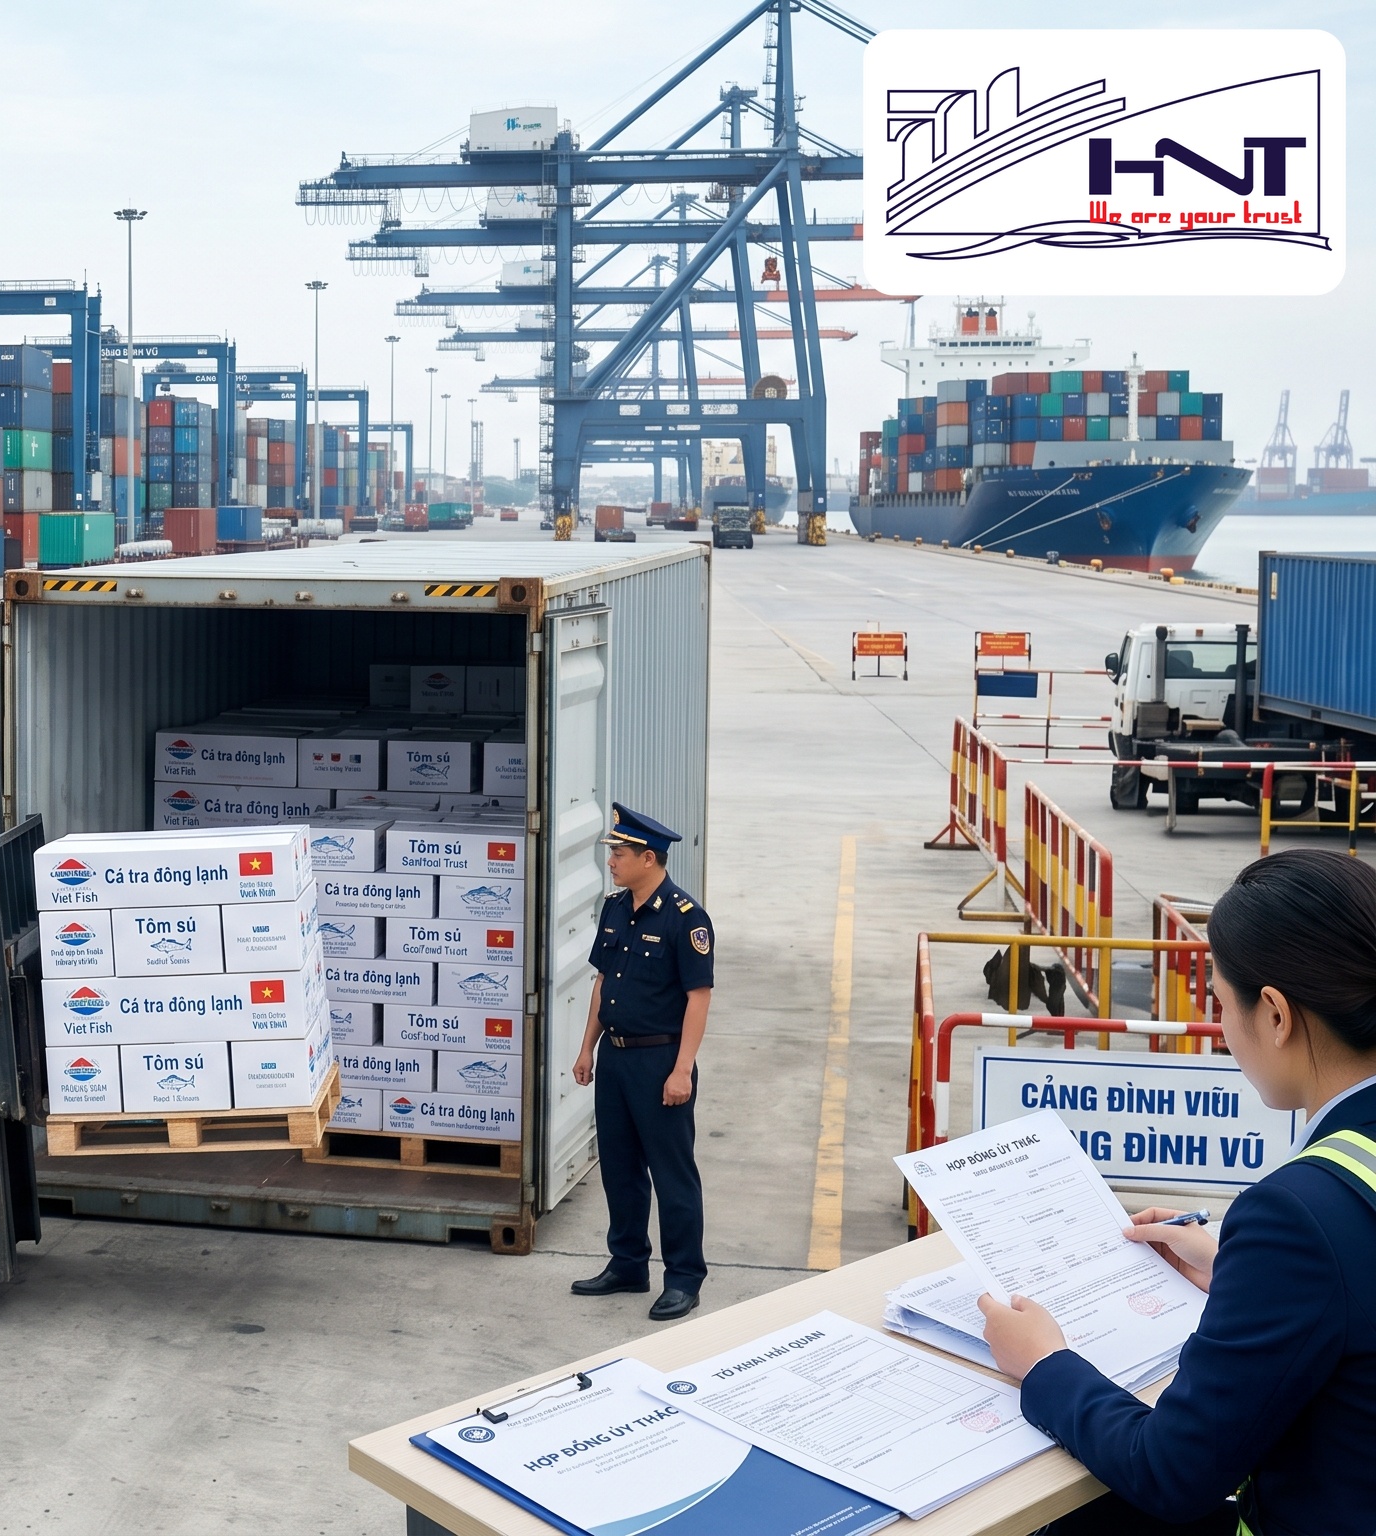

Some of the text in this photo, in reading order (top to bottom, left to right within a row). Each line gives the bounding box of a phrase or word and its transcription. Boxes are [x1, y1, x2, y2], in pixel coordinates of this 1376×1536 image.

[201, 748, 215, 761] Cá
[217, 749, 232, 762] tra
[406, 751, 450, 763] Tôm sú
[204, 799, 221, 813] Cá
[225, 801, 242, 813] tra
[247, 801, 278, 818] đông
[409, 840, 462, 855] Tôm sú
[444, 858, 468, 869] Trust
[105, 868, 124, 884] Cá
[128, 869, 149, 883] tra
[153, 866, 191, 886] đông
[196, 864, 228, 885] lạnh
[51, 891, 98, 903] Viet Fish
[324, 882, 421, 901] Cá tra đông lạnh
[135, 916, 196, 934] Tôm sú
[409, 926, 439, 941] Tôm
[325, 967, 421, 987] Cá tra đông lạnh
[120, 995, 243, 1016] Cá tra đông lạnh
[64, 1021, 113, 1035] Viet Fish
[408, 1013, 459, 1030] Tôm sú
[142, 1053, 204, 1071] Tôm sú
[395, 1058, 420, 1075] lạnh
[1021, 1074, 1098, 1111] CẢNG
[1107, 1081, 1175, 1115] ĐÌNH
[420, 1102, 435, 1116] Cá
[438, 1105, 454, 1117] tra
[491, 1107, 515, 1124] lạnh
[1123, 1126, 1207, 1166] ĐÌNH
[1219, 1131, 1264, 1169] VŨ
[788, 1330, 826, 1349] QUAN
